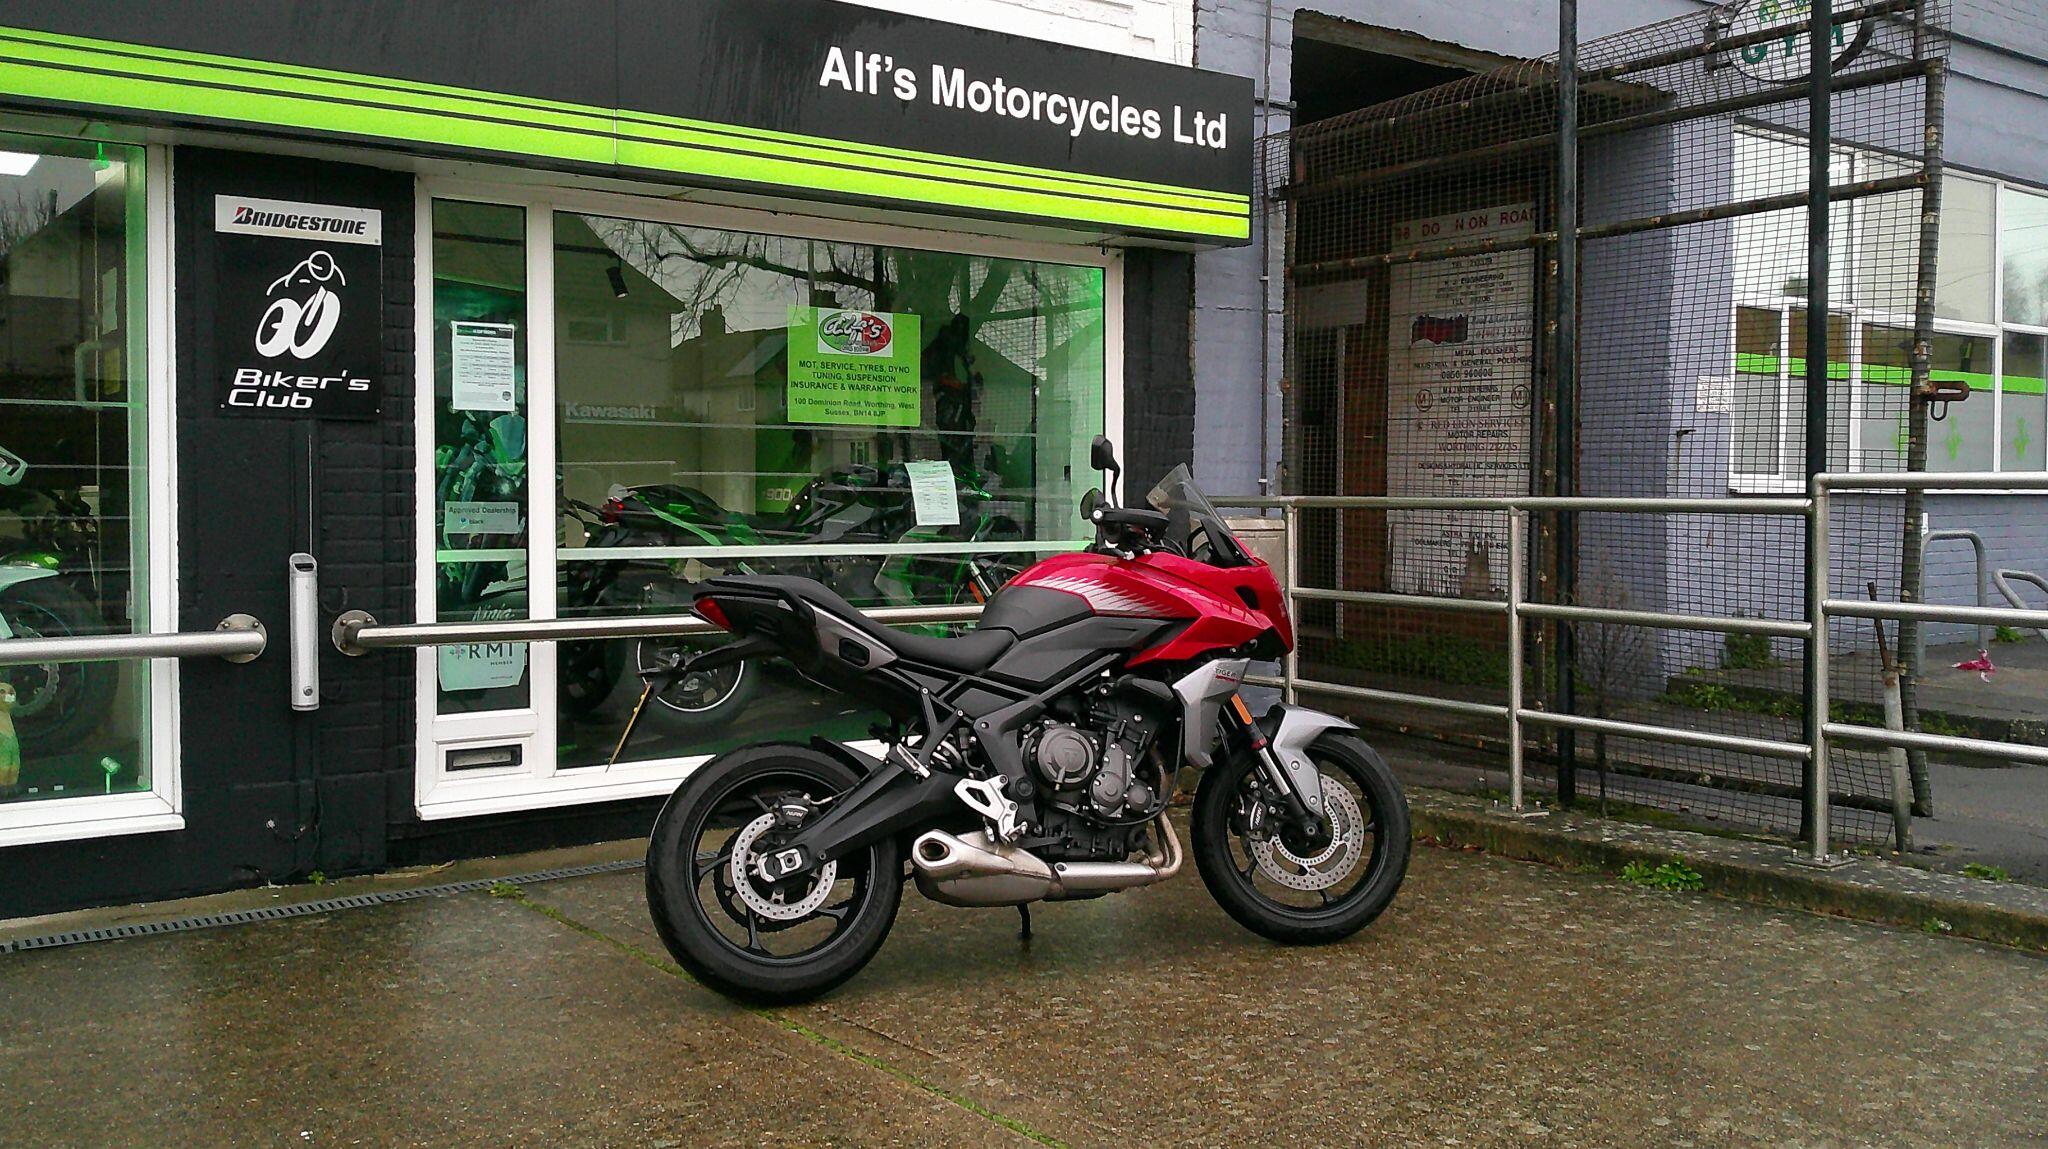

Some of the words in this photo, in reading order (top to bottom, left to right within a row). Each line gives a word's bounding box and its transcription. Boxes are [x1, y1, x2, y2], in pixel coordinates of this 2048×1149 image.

[819, 46, 918, 101] Alf's
[931, 64, 1162, 138] Motorcycles
[1174, 105, 1227, 149] Ltd
[232, 206, 367, 235] BRIDGESTONE
[1455, 349, 1476, 357] METAL
[1481, 346, 1519, 355] POLISHERS
[820, 362, 857, 371] SERVICE,
[888, 365, 910, 374] DYNO
[1461, 359, 1493, 367] GENERAL
[233, 368, 371, 391] Biker's
[812, 372, 844, 381] TUNING,
[846, 373, 896, 383] SUSPENSION
[791, 381, 838, 390] INSURANCE
[840, 383, 846, 391] &
[848, 384, 892, 393] WARRANTY
[894, 386, 918, 394] WORK
[228, 388, 313, 409] Club
[808, 398, 842, 406] Dominion
[565, 401, 656, 419] Kawasaki
[1431, 421, 1449, 430] RED
[1477, 430, 1508, 438] REPAIRS
[448, 506, 480, 515] Approved
[482, 506, 517, 515] Dealership
[472, 603, 515, 622] Ninja
[469, 642, 513, 660] RMI
[1215, 668, 1237, 678] TIGER
